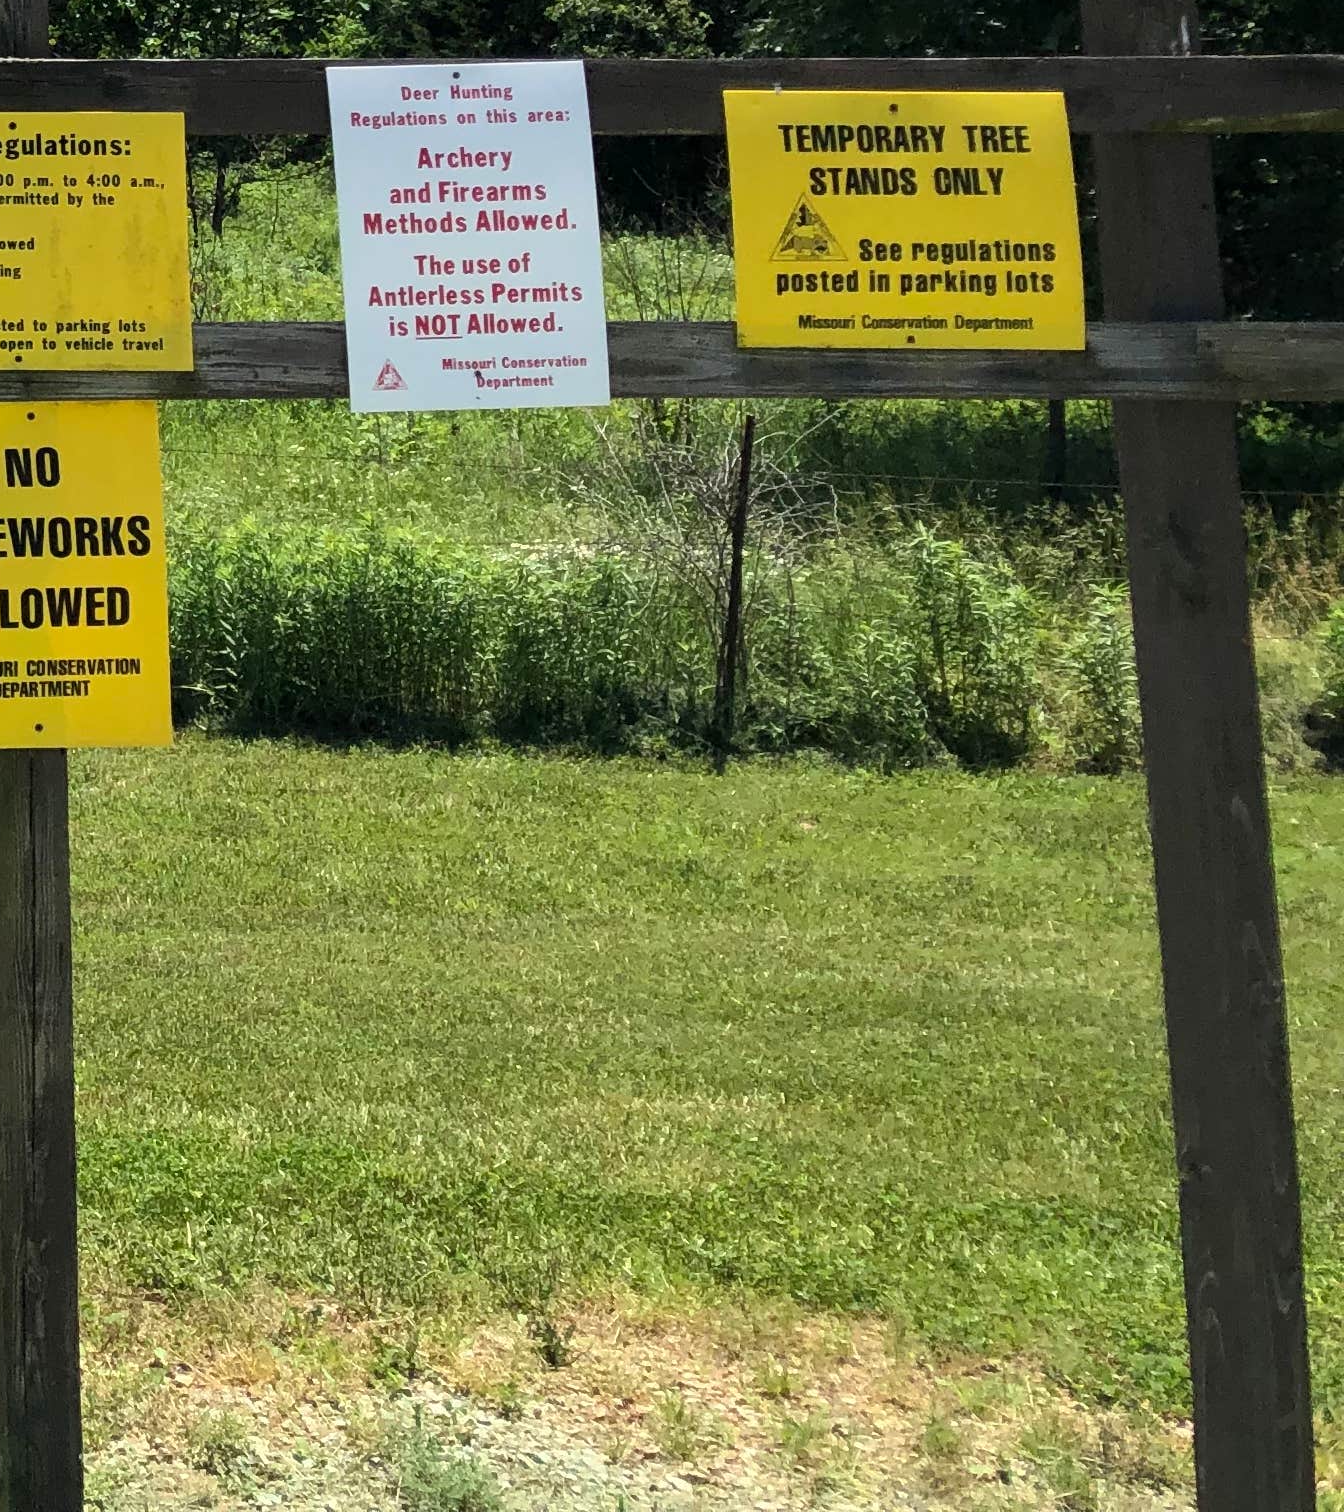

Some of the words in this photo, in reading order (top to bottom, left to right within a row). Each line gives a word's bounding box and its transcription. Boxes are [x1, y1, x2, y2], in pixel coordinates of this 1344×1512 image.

[401, 86, 439, 100] Deer
[450, 84, 512, 101] Hunting
[350, 111, 446, 129] Regulations
[456, 113, 475, 124] on
[486, 109, 516, 123] this
[528, 110, 569, 122] area:
[778, 124, 944, 152] TEMPORARY
[961, 125, 1030, 152] TREE
[418, 146, 511, 171] Archery
[23, 177, 53, 189] p.m.
[63, 175, 76, 186] to
[86, 174, 120, 187] 4:00
[390, 182, 430, 203] and
[438, 180, 546, 202] Firearms
[809, 167, 917, 195] STANDS
[933, 167, 1003, 195] ONLY
[67, 192, 82, 207] by
[92, 192, 114, 205] the
[363, 211, 466, 234] Methods
[476, 208, 576, 231] Allowed.
[859, 238, 901, 261] See
[911, 239, 1055, 264] regulations
[413, 254, 454, 275] The
[462, 258, 500, 274] use
[508, 252, 530, 273] of
[368, 284, 484, 306] Antlerless
[492, 282, 582, 303] Permits
[776, 270, 858, 295] posted
[869, 270, 889, 292] in
[900, 270, 996, 296] parking
[1006, 270, 1053, 292] lots
[32, 319, 47, 331] to
[56, 319, 110, 334] parking
[118, 319, 145, 332] lots
[389, 316, 408, 336] is
[415, 314, 462, 339] NOT
[467, 312, 562, 334] Allowed.
[798, 314, 855, 329] Missouri
[861, 314, 947, 329] Conservation
[954, 315, 1033, 332] Department
[0, 340, 33, 352] open
[42, 338, 56, 349] to
[65, 337, 113, 350] vehicle
[122, 338, 163, 350] travel
[442, 357, 495, 372] Missouri
[501, 354, 586, 368] Conservation
[474, 373, 553, 390] Department
[4, 447, 60, 487] NO
[26, 657, 140, 676] CONSERVATION
